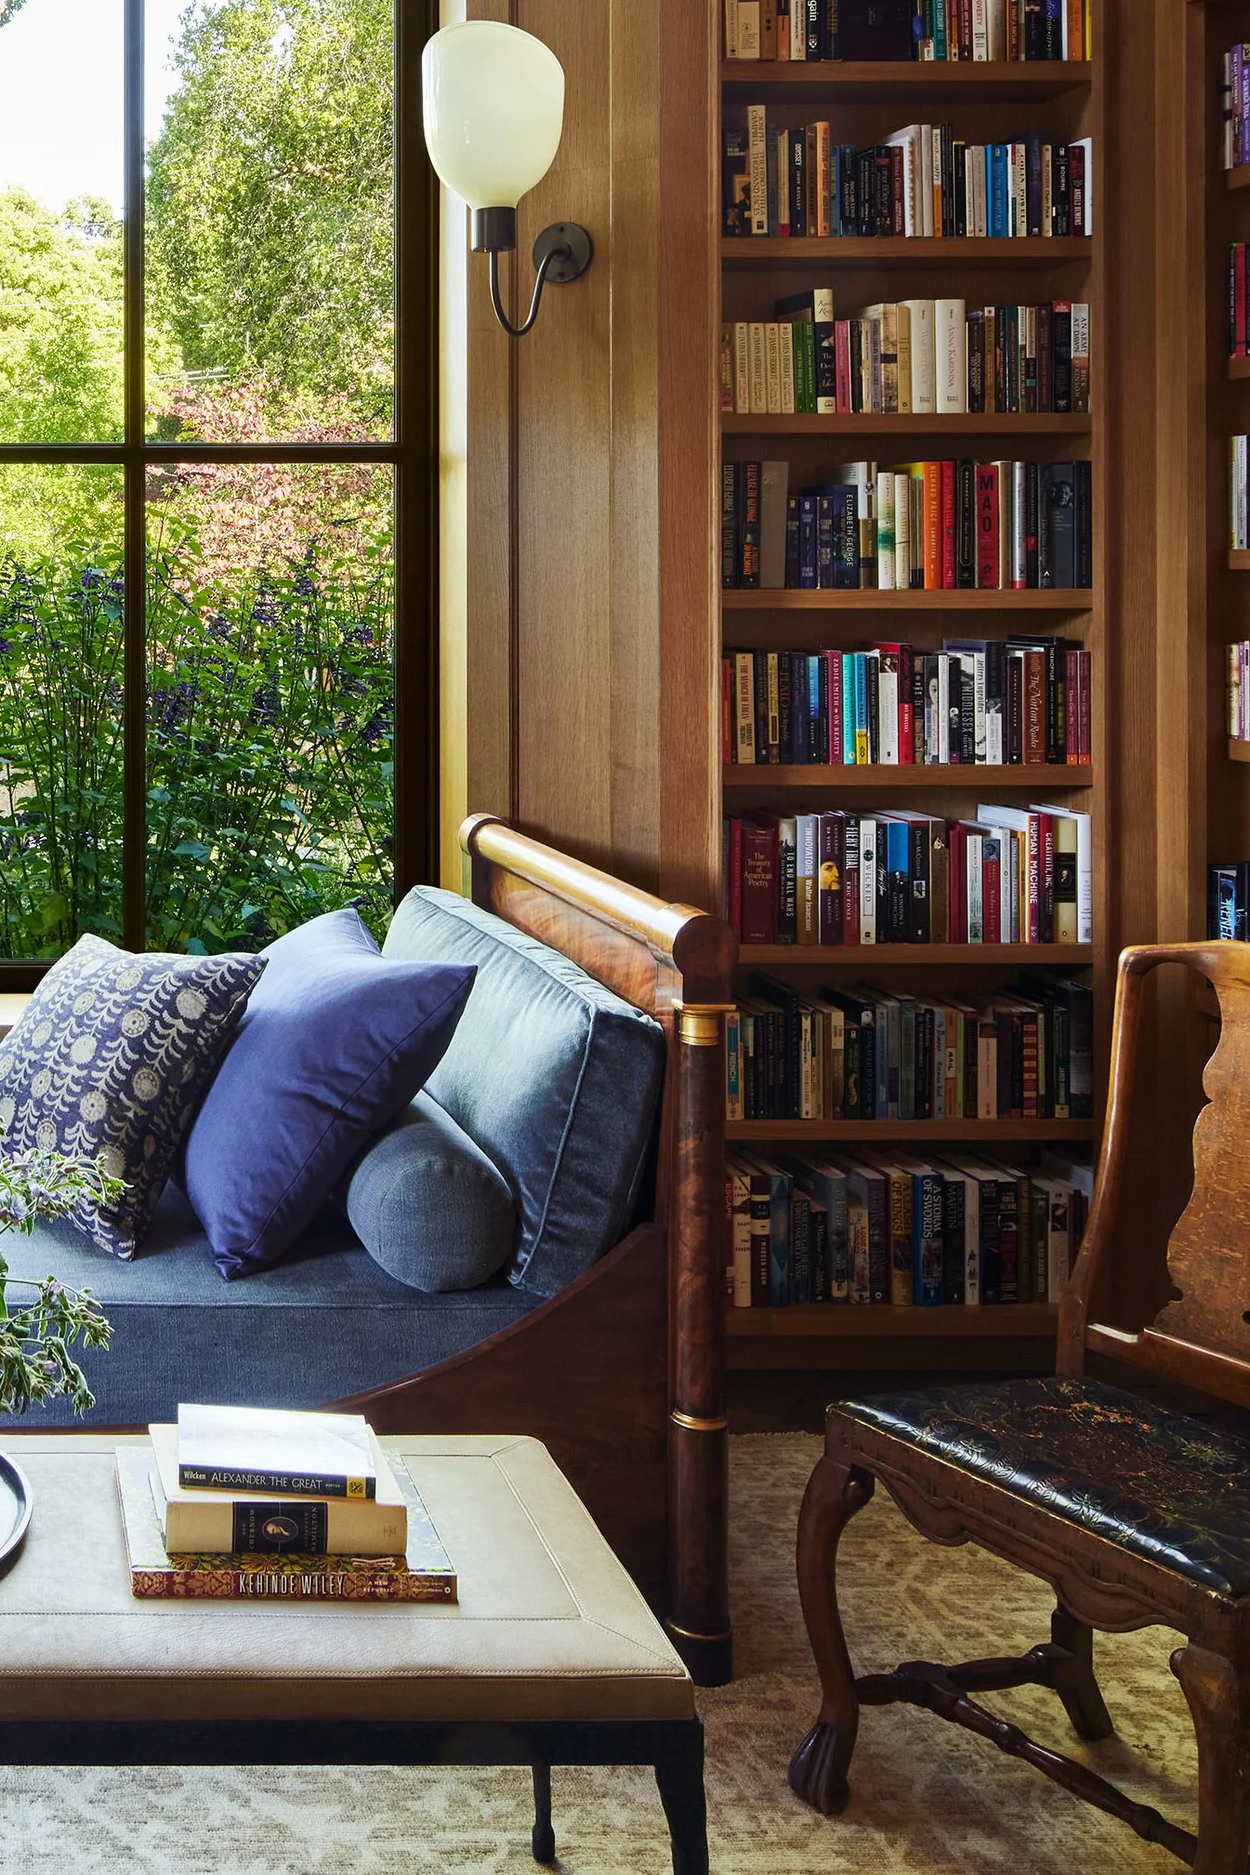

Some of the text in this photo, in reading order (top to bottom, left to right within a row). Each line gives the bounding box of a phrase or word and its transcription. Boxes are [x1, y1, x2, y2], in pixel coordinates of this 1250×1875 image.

[808, 0, 819, 21] gain
[751, 109, 759, 146] CAMPBELL
[758, 116, 766, 142] JOSEPH
[758, 151, 766, 165] THE
[758, 166, 766, 184] HERO
[758, 186, 766, 206] WITH
[1074, 317, 1081, 327] AT
[1081, 317, 1088, 327] AN
[782, 336, 790, 379] JAMES HERRIOT
[948, 325, 957, 387] ANNA KARENINA
[929, 465, 937, 558] RICHARD PRICE SAMARITAN
[980, 475, 994, 532] MAO
[780, 672, 790, 707] PLATO
[833, 714, 840, 726] ON
[961, 686, 974, 732] MIDDLESEX
[1030, 675, 1040, 748] The Norton Reader
[746, 860, 772, 870] Treasury
[804, 827, 813, 931] INNOVATORS Walter Isaacson
[1030, 821, 1038, 903] HUMAN MACHINE
[748, 879, 770, 889] Poetry
[786, 852, 794, 917] TO END ALL WARS
[729, 1051, 738, 1082] FRENCH
[893, 1181, 902, 1231] OF KINGS
[902, 1193, 911, 1230] CLASH
[923, 1179, 933, 1238] OF SWORDS
[933, 1195, 942, 1230] STORM
[183, 1470, 323, 1490] Wilcken ALEXANDER THE GREAT
[310, 1506, 318, 1552] HAMILTON
[239, 1573, 345, 1596] KEHINDE WILEY
